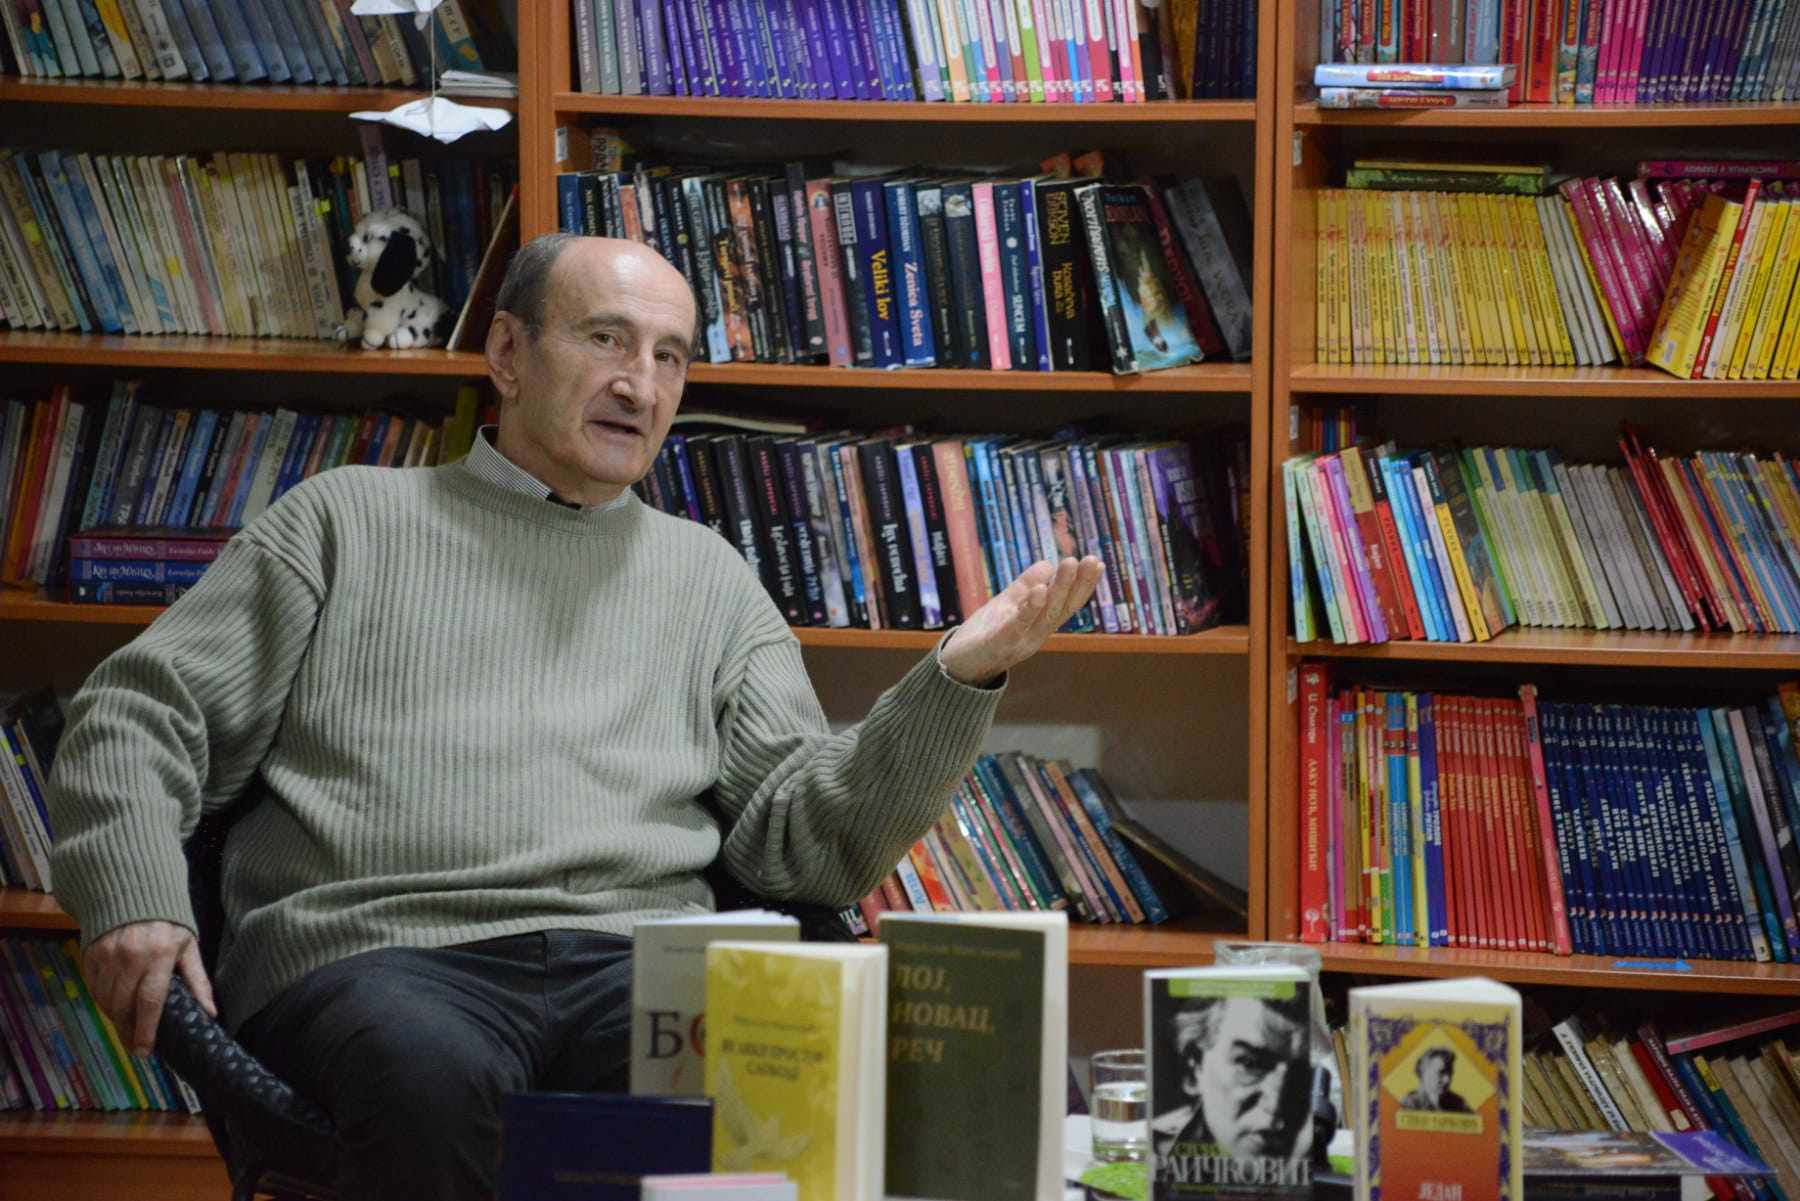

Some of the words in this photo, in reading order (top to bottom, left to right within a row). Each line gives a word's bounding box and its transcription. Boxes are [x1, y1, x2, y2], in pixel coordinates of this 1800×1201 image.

[870, 249, 889, 294] Veliki
[903, 261, 919, 306] Zenica
[876, 298, 889, 320] lov
[909, 309, 924, 346] Sveta
[1556, 822, 1571, 874] ЛЕПОТИЦА
